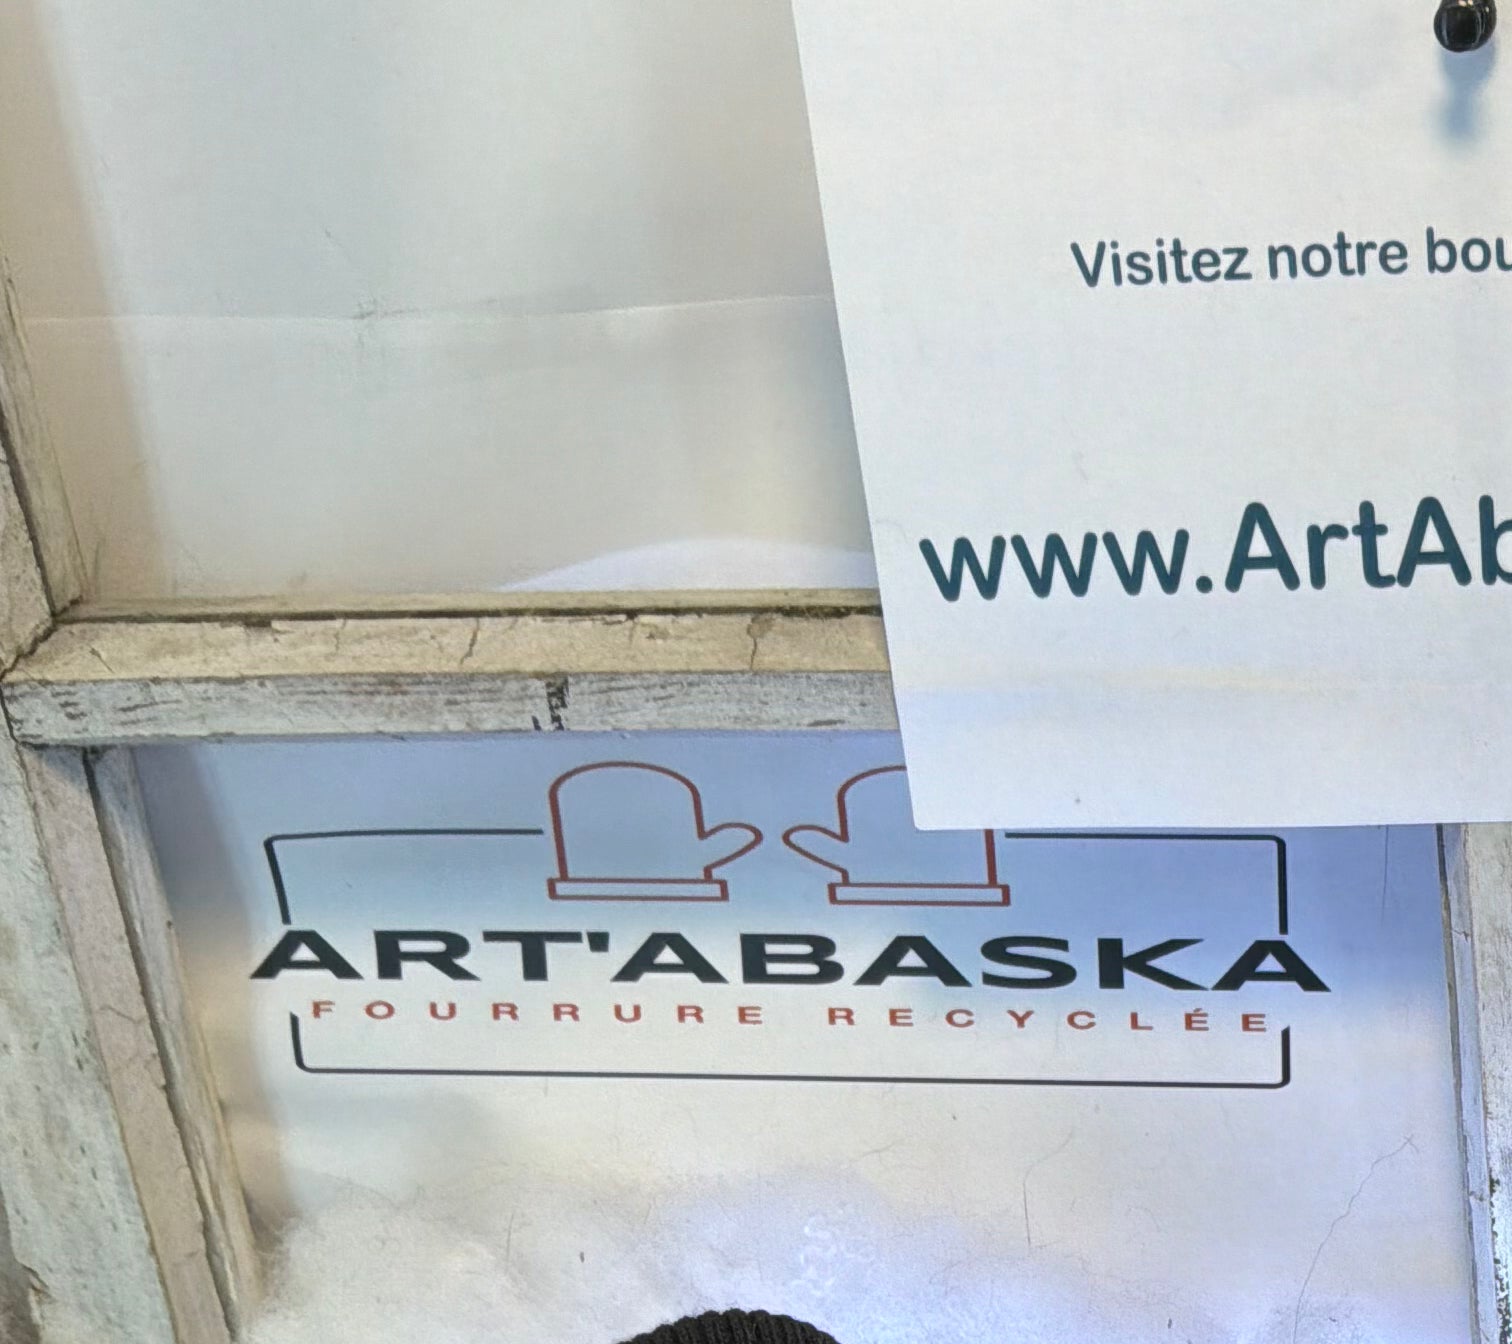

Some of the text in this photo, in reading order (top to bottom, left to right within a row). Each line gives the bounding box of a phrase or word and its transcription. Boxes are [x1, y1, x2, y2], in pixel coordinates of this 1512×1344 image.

[1070, 238, 1253, 289] Visitez
[1268, 231, 1408, 280] notre
[250, 928, 1331, 993] ART'ABASKA
[311, 1000, 1270, 1034] FOURRURE RECYCLÉE
